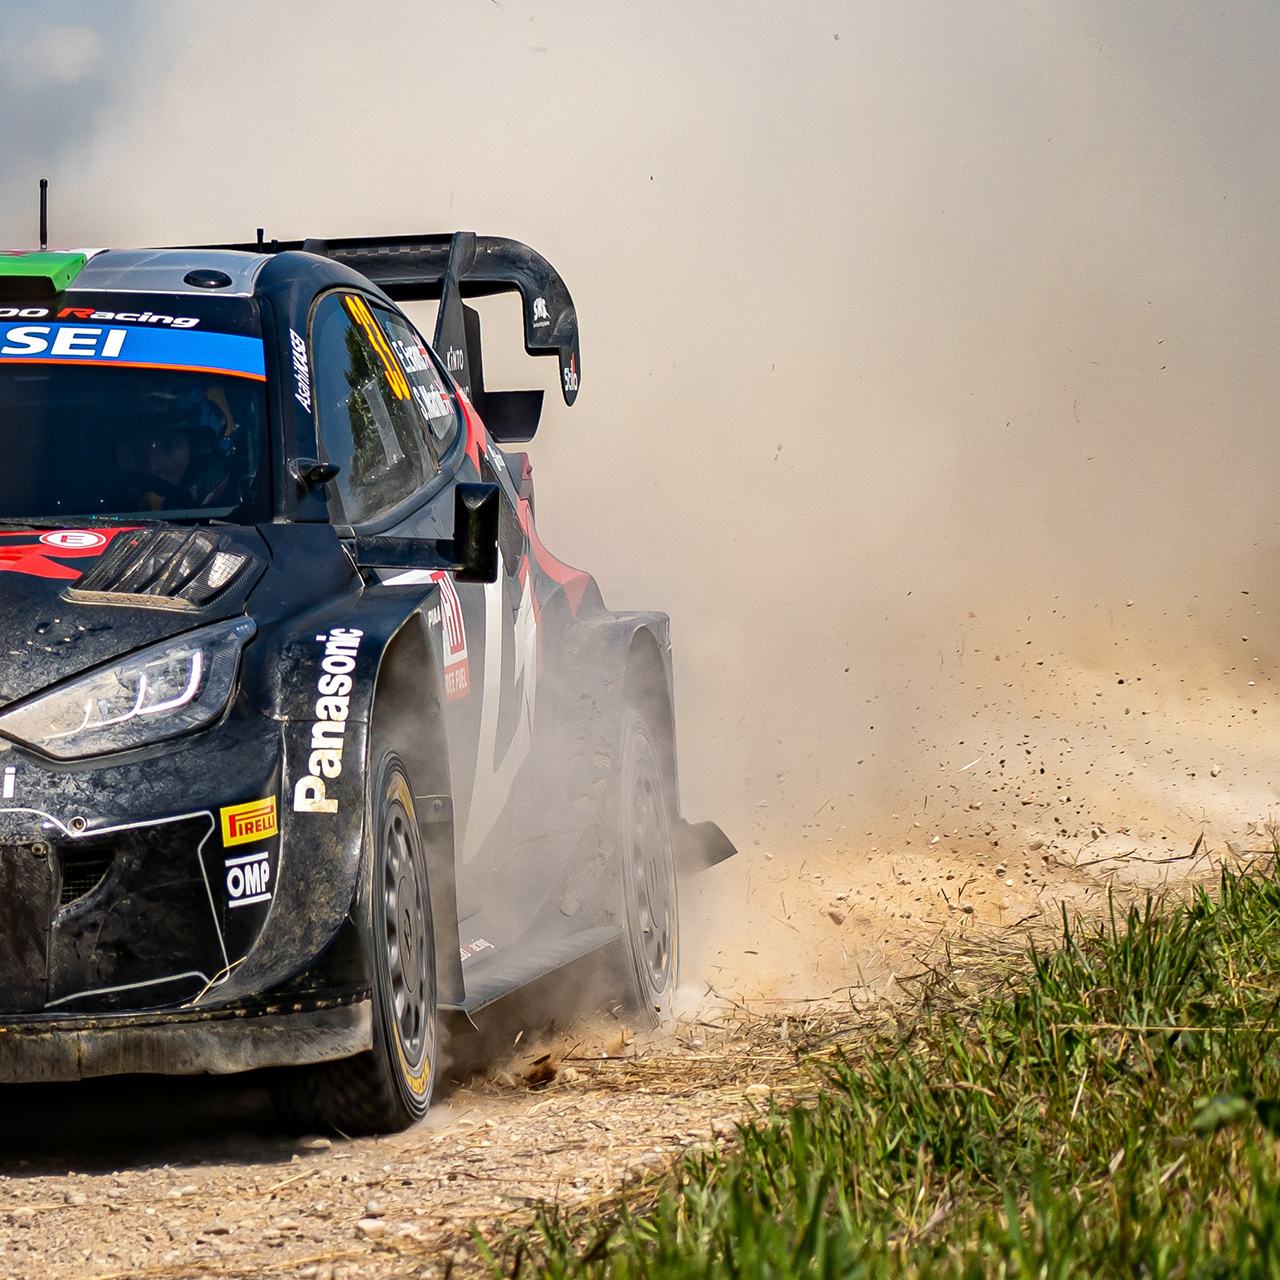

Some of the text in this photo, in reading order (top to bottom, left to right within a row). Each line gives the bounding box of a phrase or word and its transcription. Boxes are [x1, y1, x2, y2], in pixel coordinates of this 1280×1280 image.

[56, 307, 201, 328] Racing
[292, 627, 364, 814] Panasonic
[228, 803, 278, 838] PIRELLI
[227, 859, 271, 898] OMP
